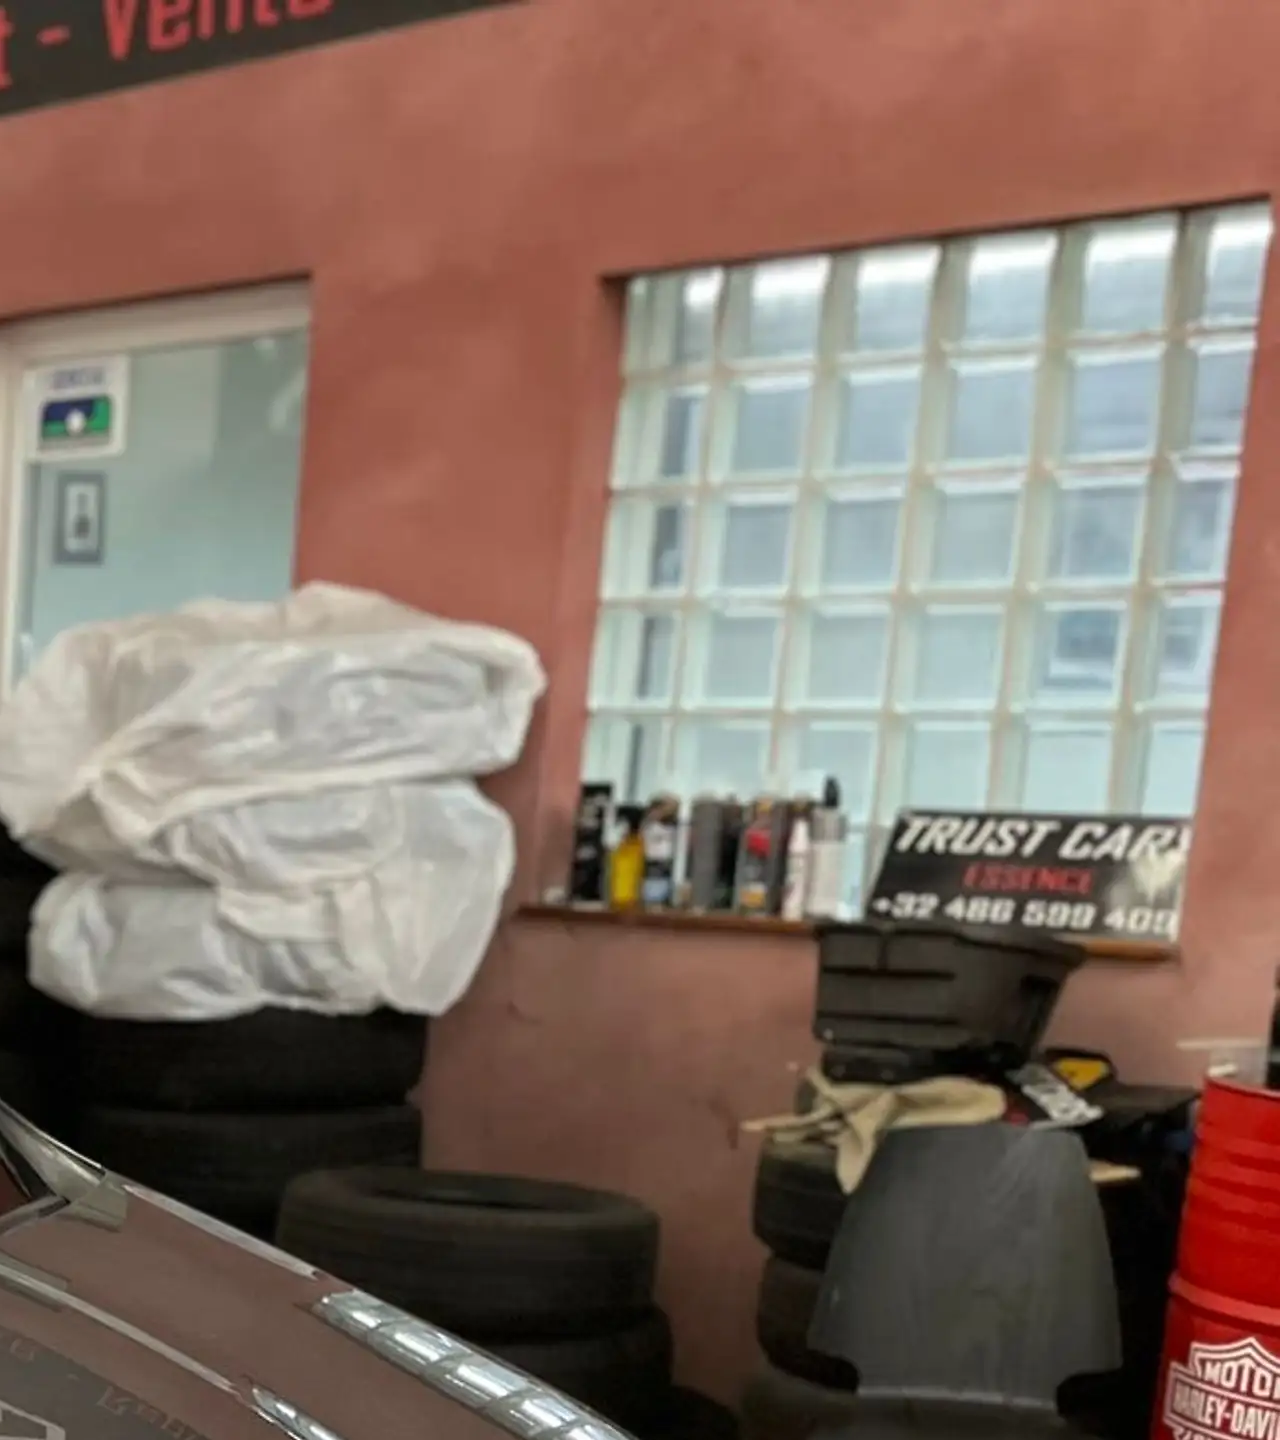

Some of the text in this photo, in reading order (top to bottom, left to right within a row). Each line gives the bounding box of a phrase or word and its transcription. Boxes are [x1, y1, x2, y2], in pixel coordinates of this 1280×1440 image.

[895, 816, 1061, 858] TRUST
[872, 892, 939, 919] +32
[1203, 1356, 1280, 1401] MOTO
